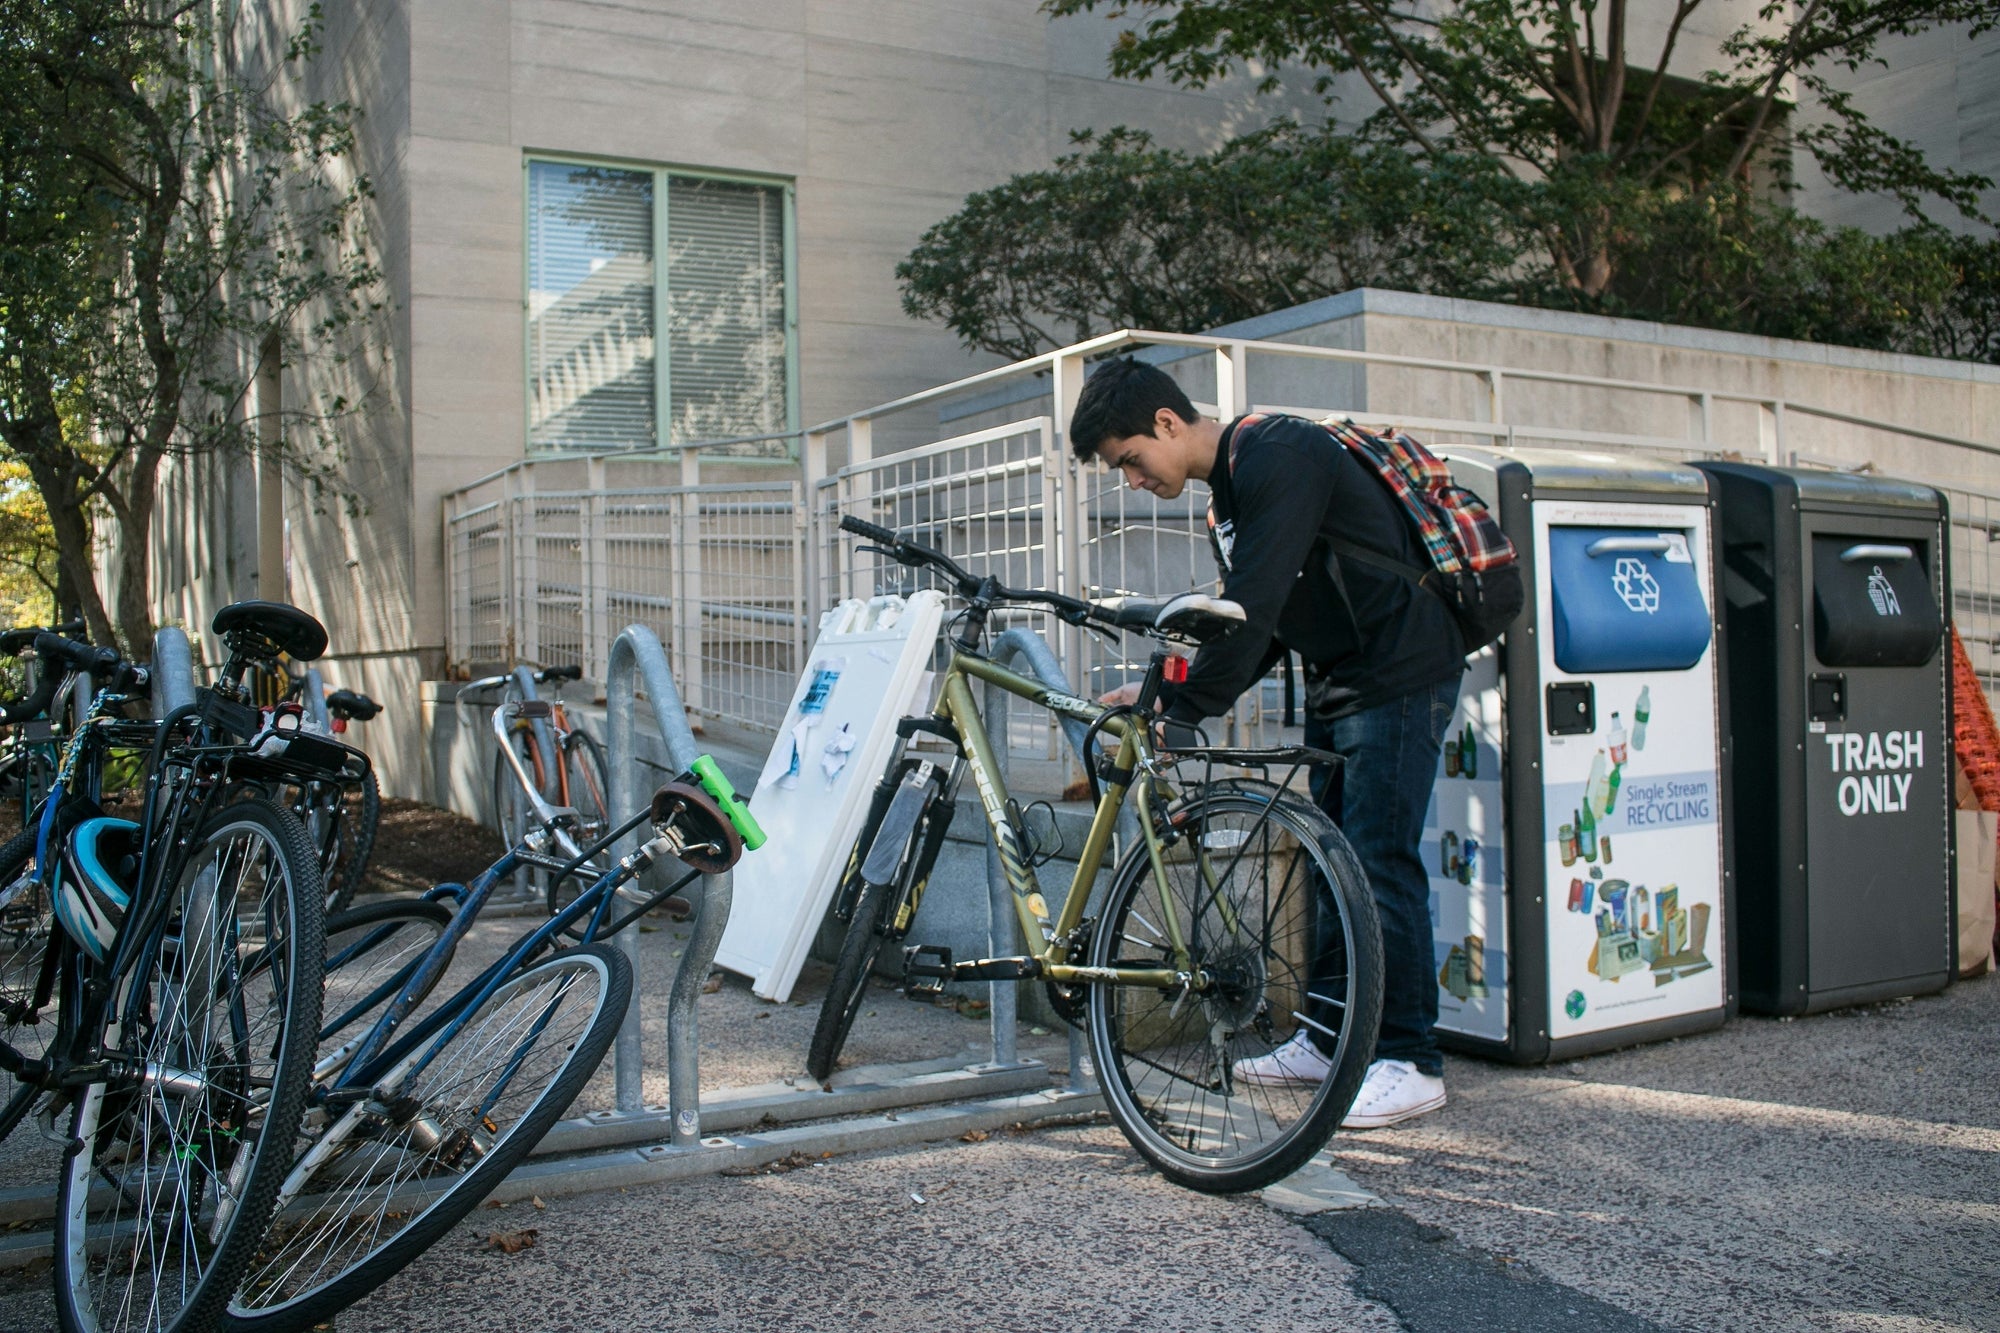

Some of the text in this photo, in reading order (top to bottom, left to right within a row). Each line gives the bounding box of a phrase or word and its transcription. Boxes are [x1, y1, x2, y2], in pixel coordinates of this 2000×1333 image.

[1045, 690, 1089, 713] 3900
[1825, 730, 1924, 773] TRASH
[962, 727, 1015, 841] TREK
[1626, 781, 1708, 803] Single Stream
[1838, 773, 1912, 817] ONLY
[1627, 798, 1709, 827] RECYCLING
